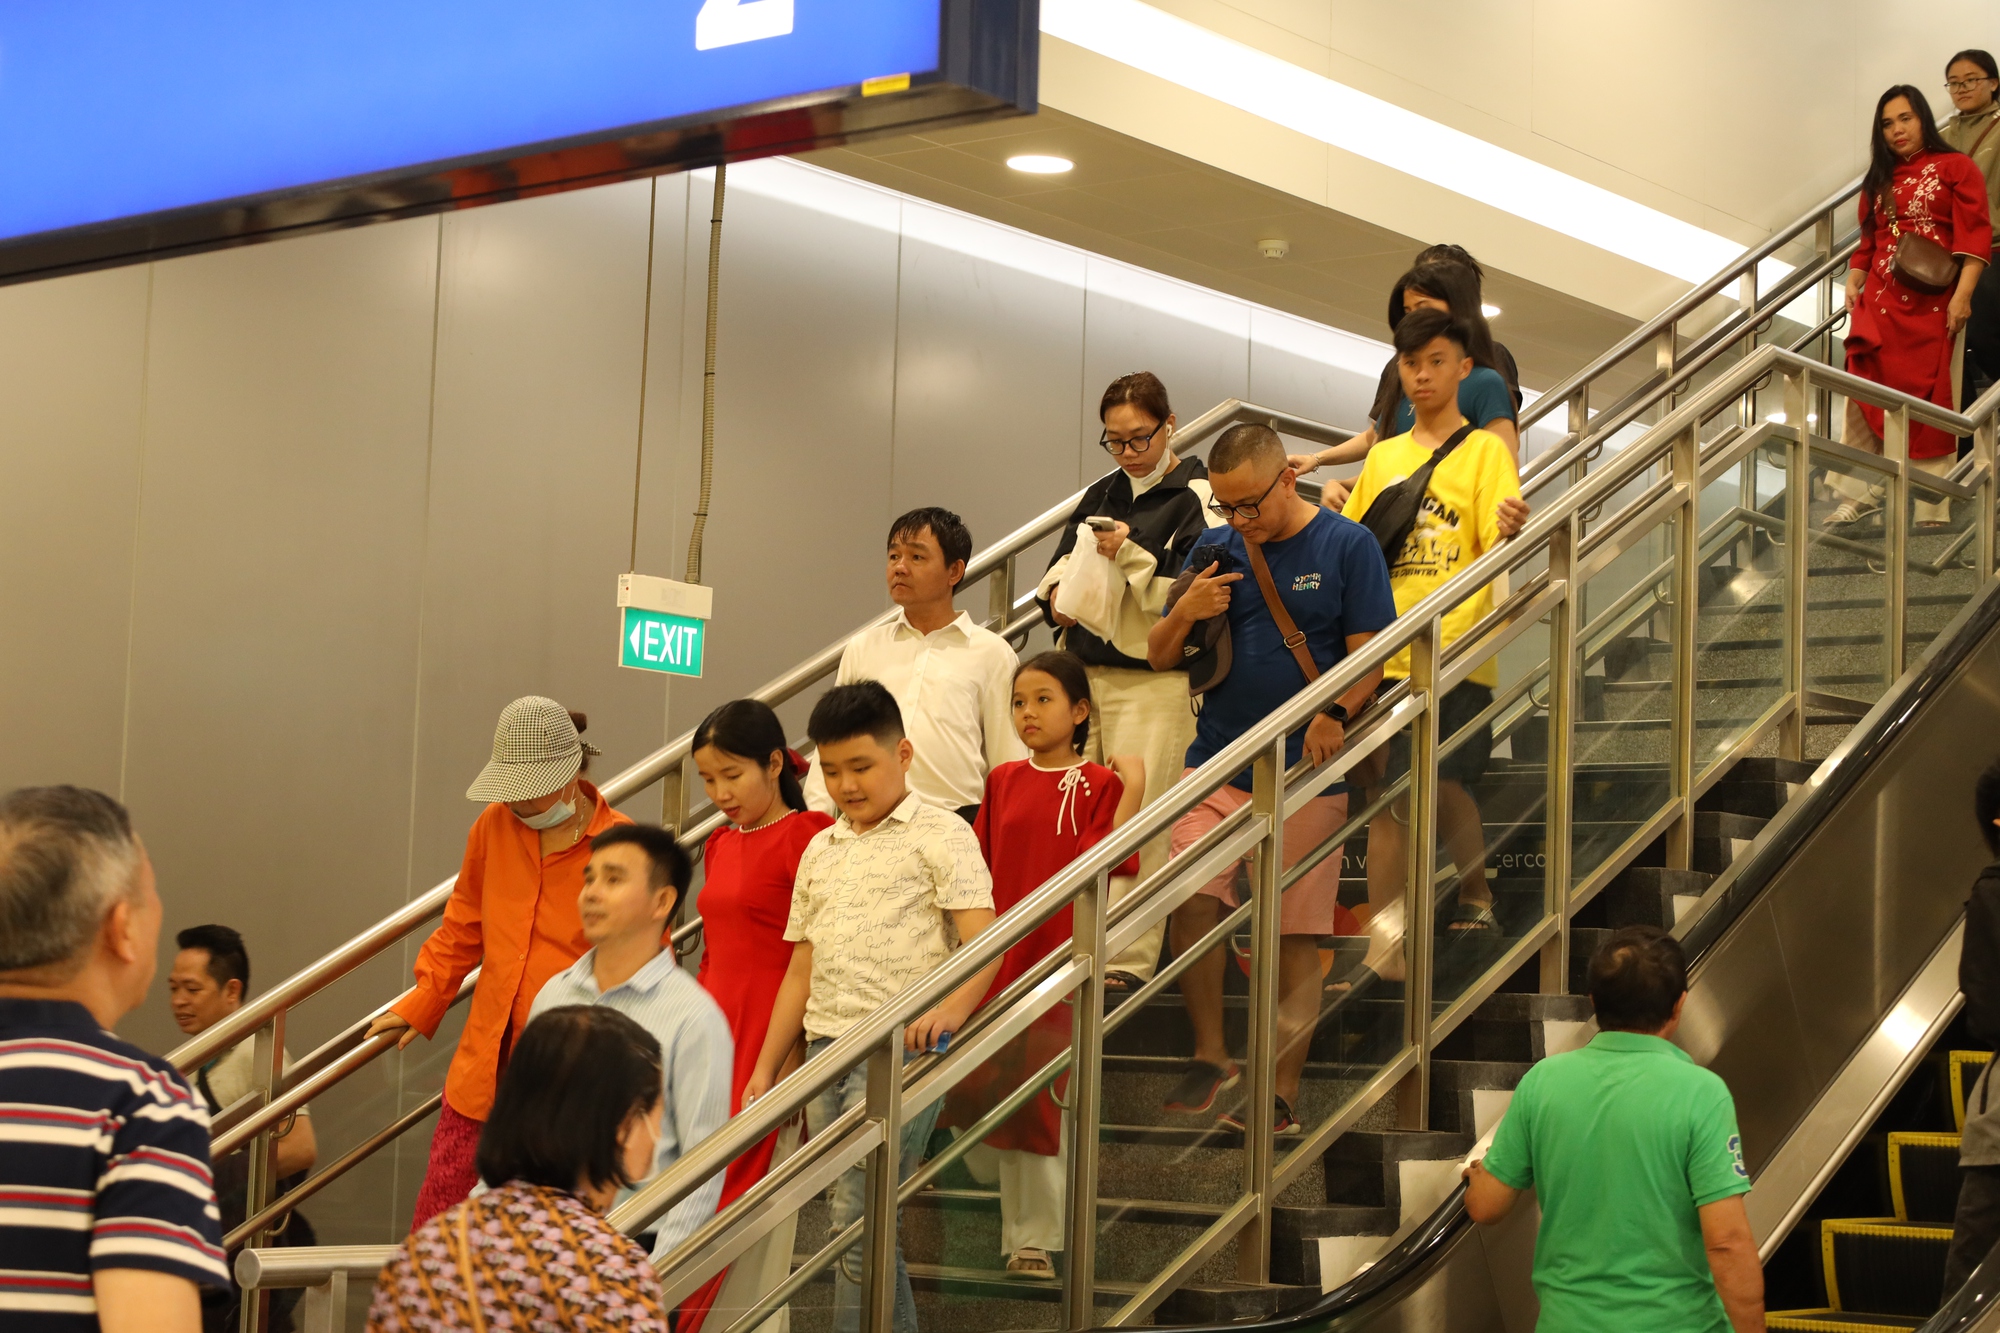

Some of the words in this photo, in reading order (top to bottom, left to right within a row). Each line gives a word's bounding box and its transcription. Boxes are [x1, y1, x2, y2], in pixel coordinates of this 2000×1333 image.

[1421, 496, 1460, 528] GAN
[1292, 581, 1320, 591] HENRY
[643, 620, 698, 667] EXIT
